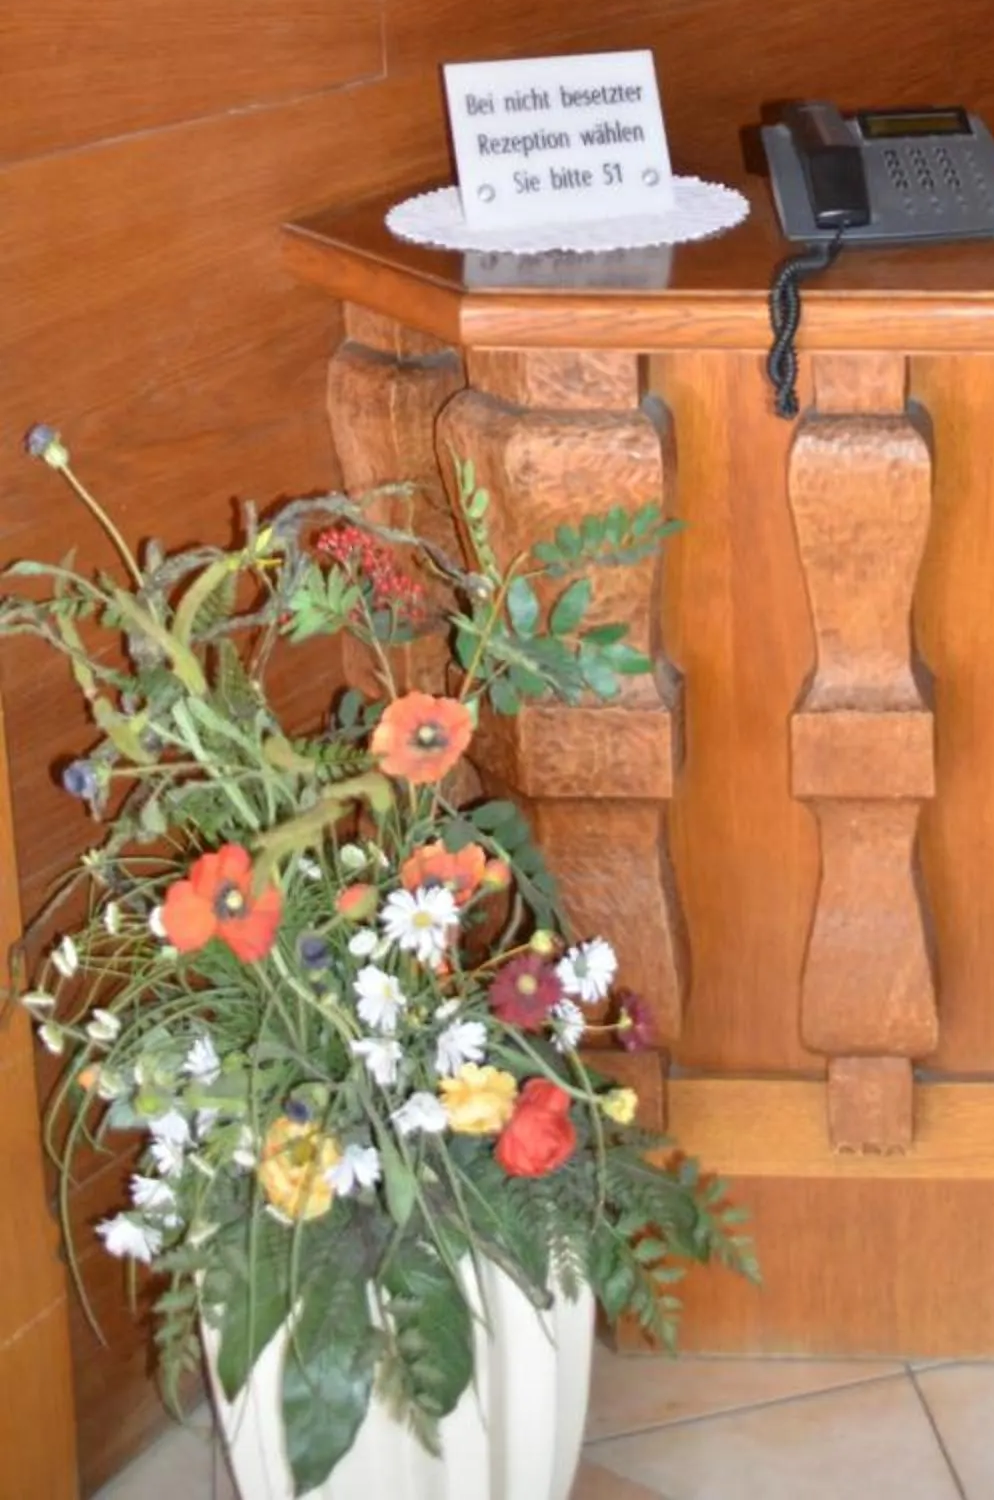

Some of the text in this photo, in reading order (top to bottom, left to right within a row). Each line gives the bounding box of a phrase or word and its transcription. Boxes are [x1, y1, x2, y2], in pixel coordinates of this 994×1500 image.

[465, 84, 643, 116] Bei nicht besetzter
[477, 120, 646, 157] Rezeption wählen
[512, 162, 623, 195] Sie bitte 51
